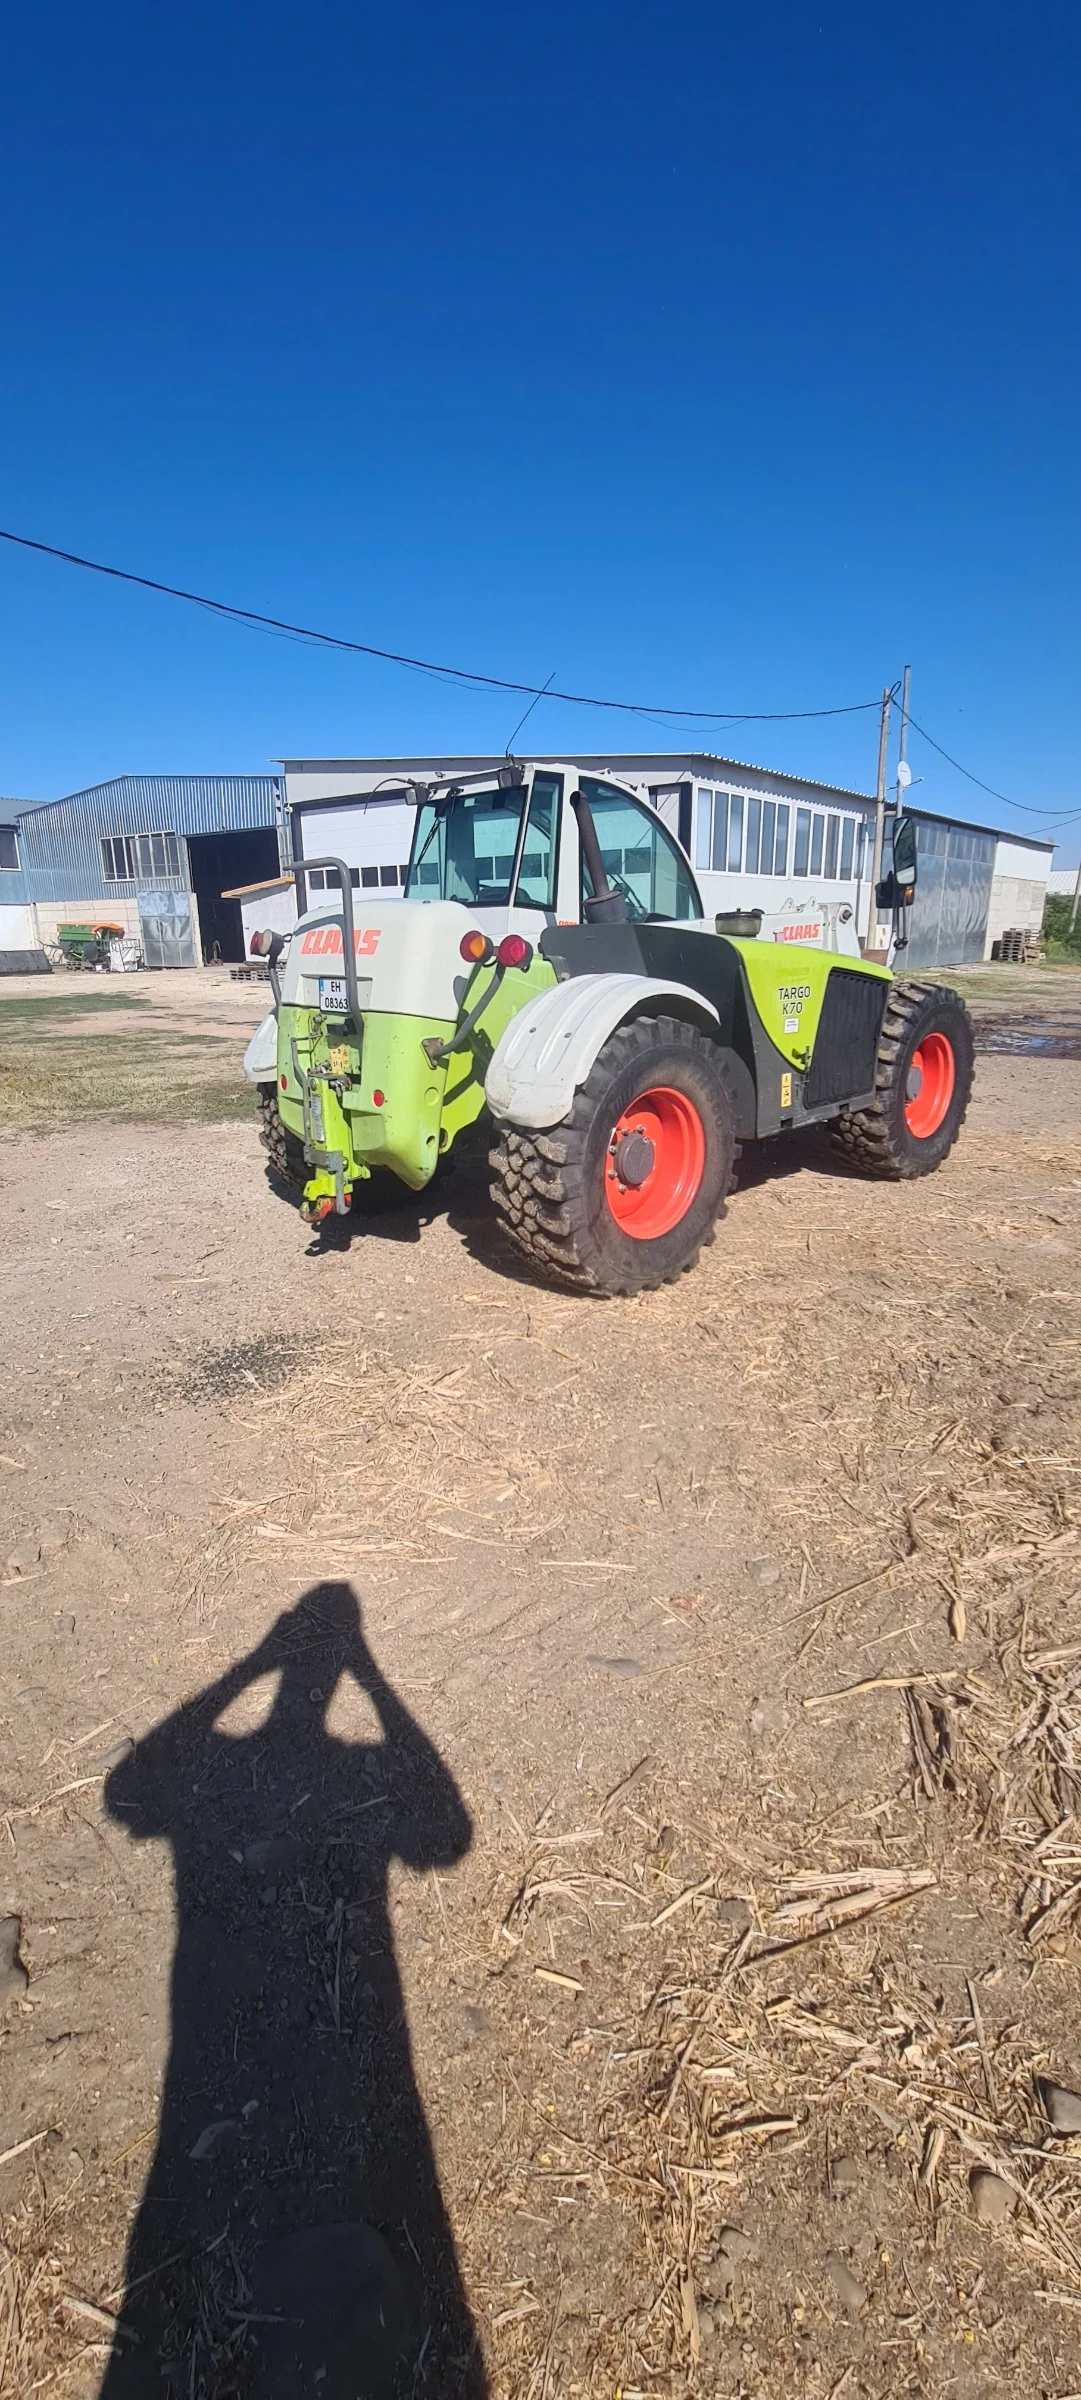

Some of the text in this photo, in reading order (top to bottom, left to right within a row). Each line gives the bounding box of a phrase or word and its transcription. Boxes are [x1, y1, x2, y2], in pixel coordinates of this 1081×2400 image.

[783, 924, 821, 940] CLAAS
[330, 981, 341, 992] EH
[778, 986, 811, 1000] TARGO
[325, 996, 348, 1009] 08363
[782, 1002, 803, 1015] K70
